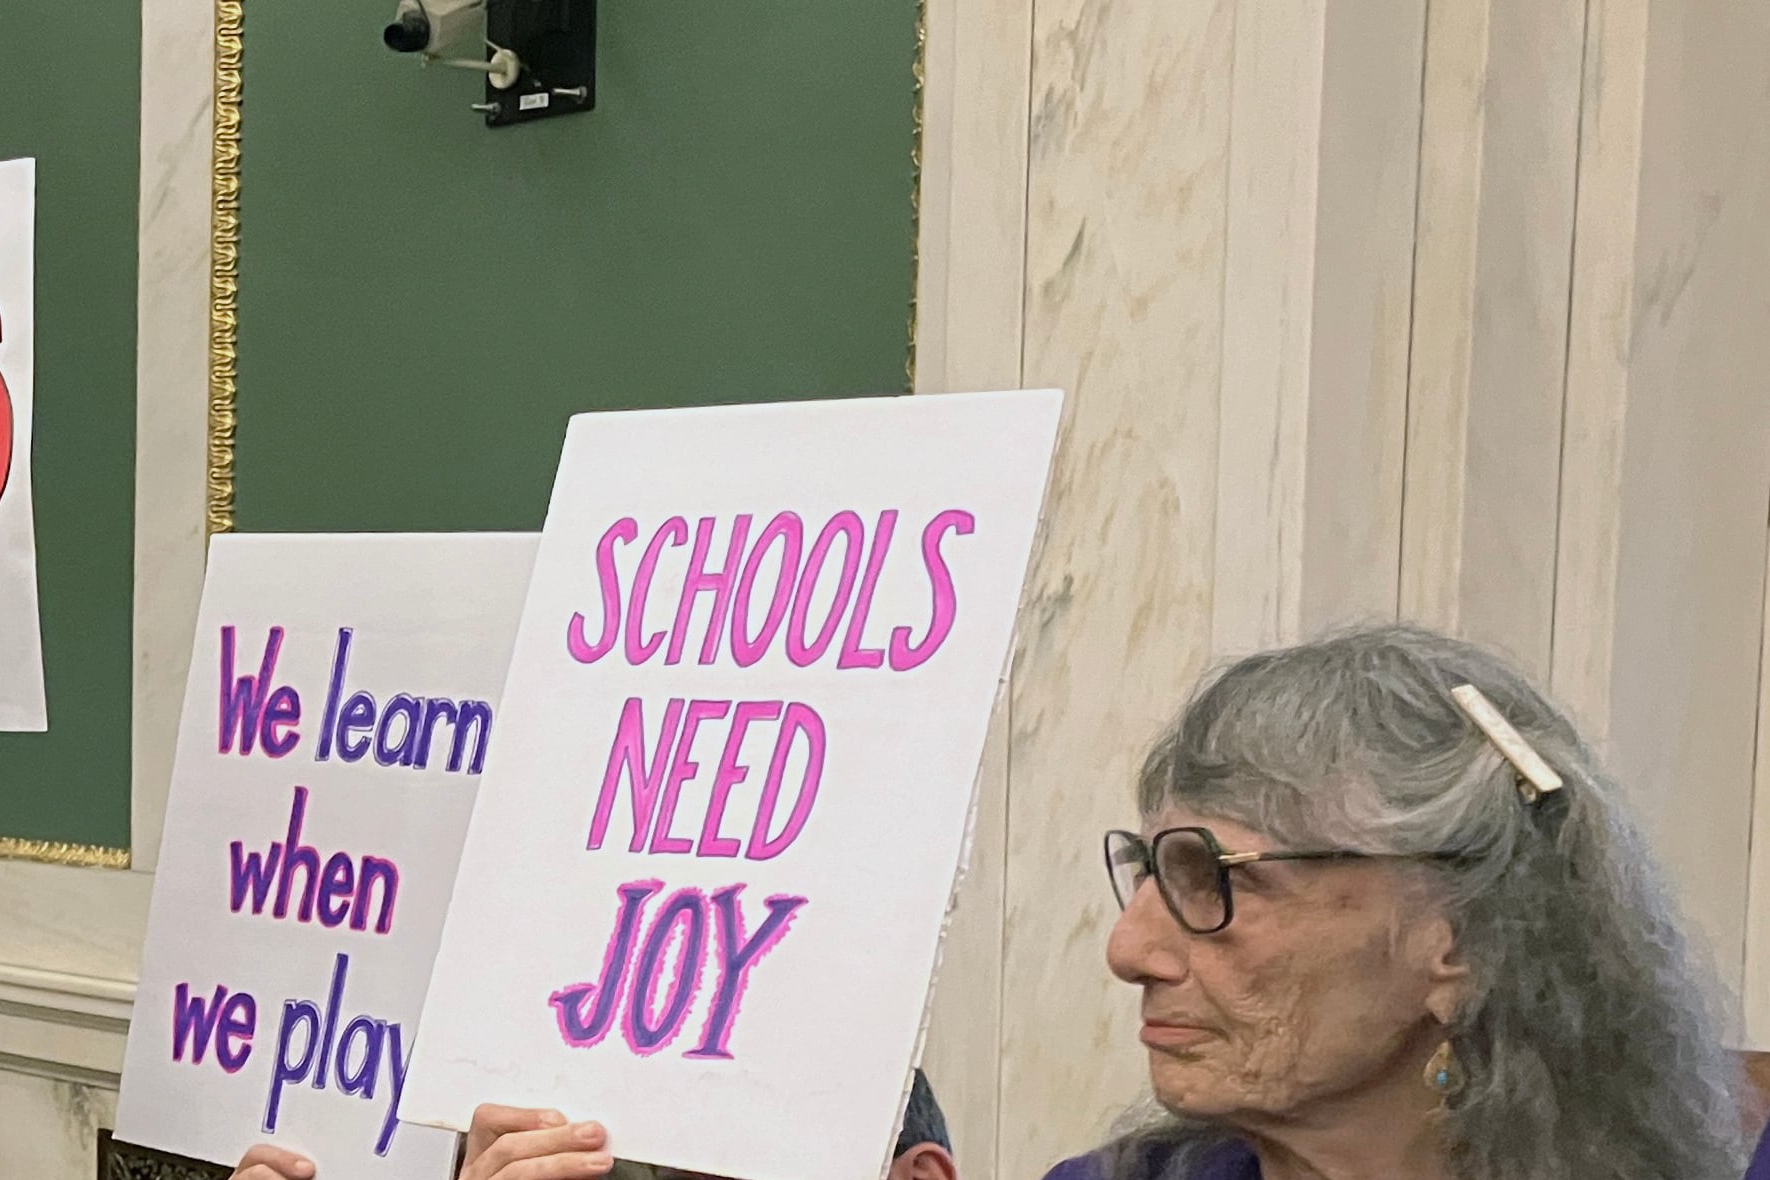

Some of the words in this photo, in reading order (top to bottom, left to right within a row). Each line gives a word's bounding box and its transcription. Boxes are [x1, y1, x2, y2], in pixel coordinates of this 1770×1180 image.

[566, 508, 976, 672] SCHOOLS
[218, 625, 301, 758] We
[314, 627, 491, 776] learn
[586, 697, 827, 861] NEED
[229, 786, 400, 936] when
[549, 878, 809, 1060] JOY
[172, 982, 257, 1074] we
[261, 954, 408, 1158] play
